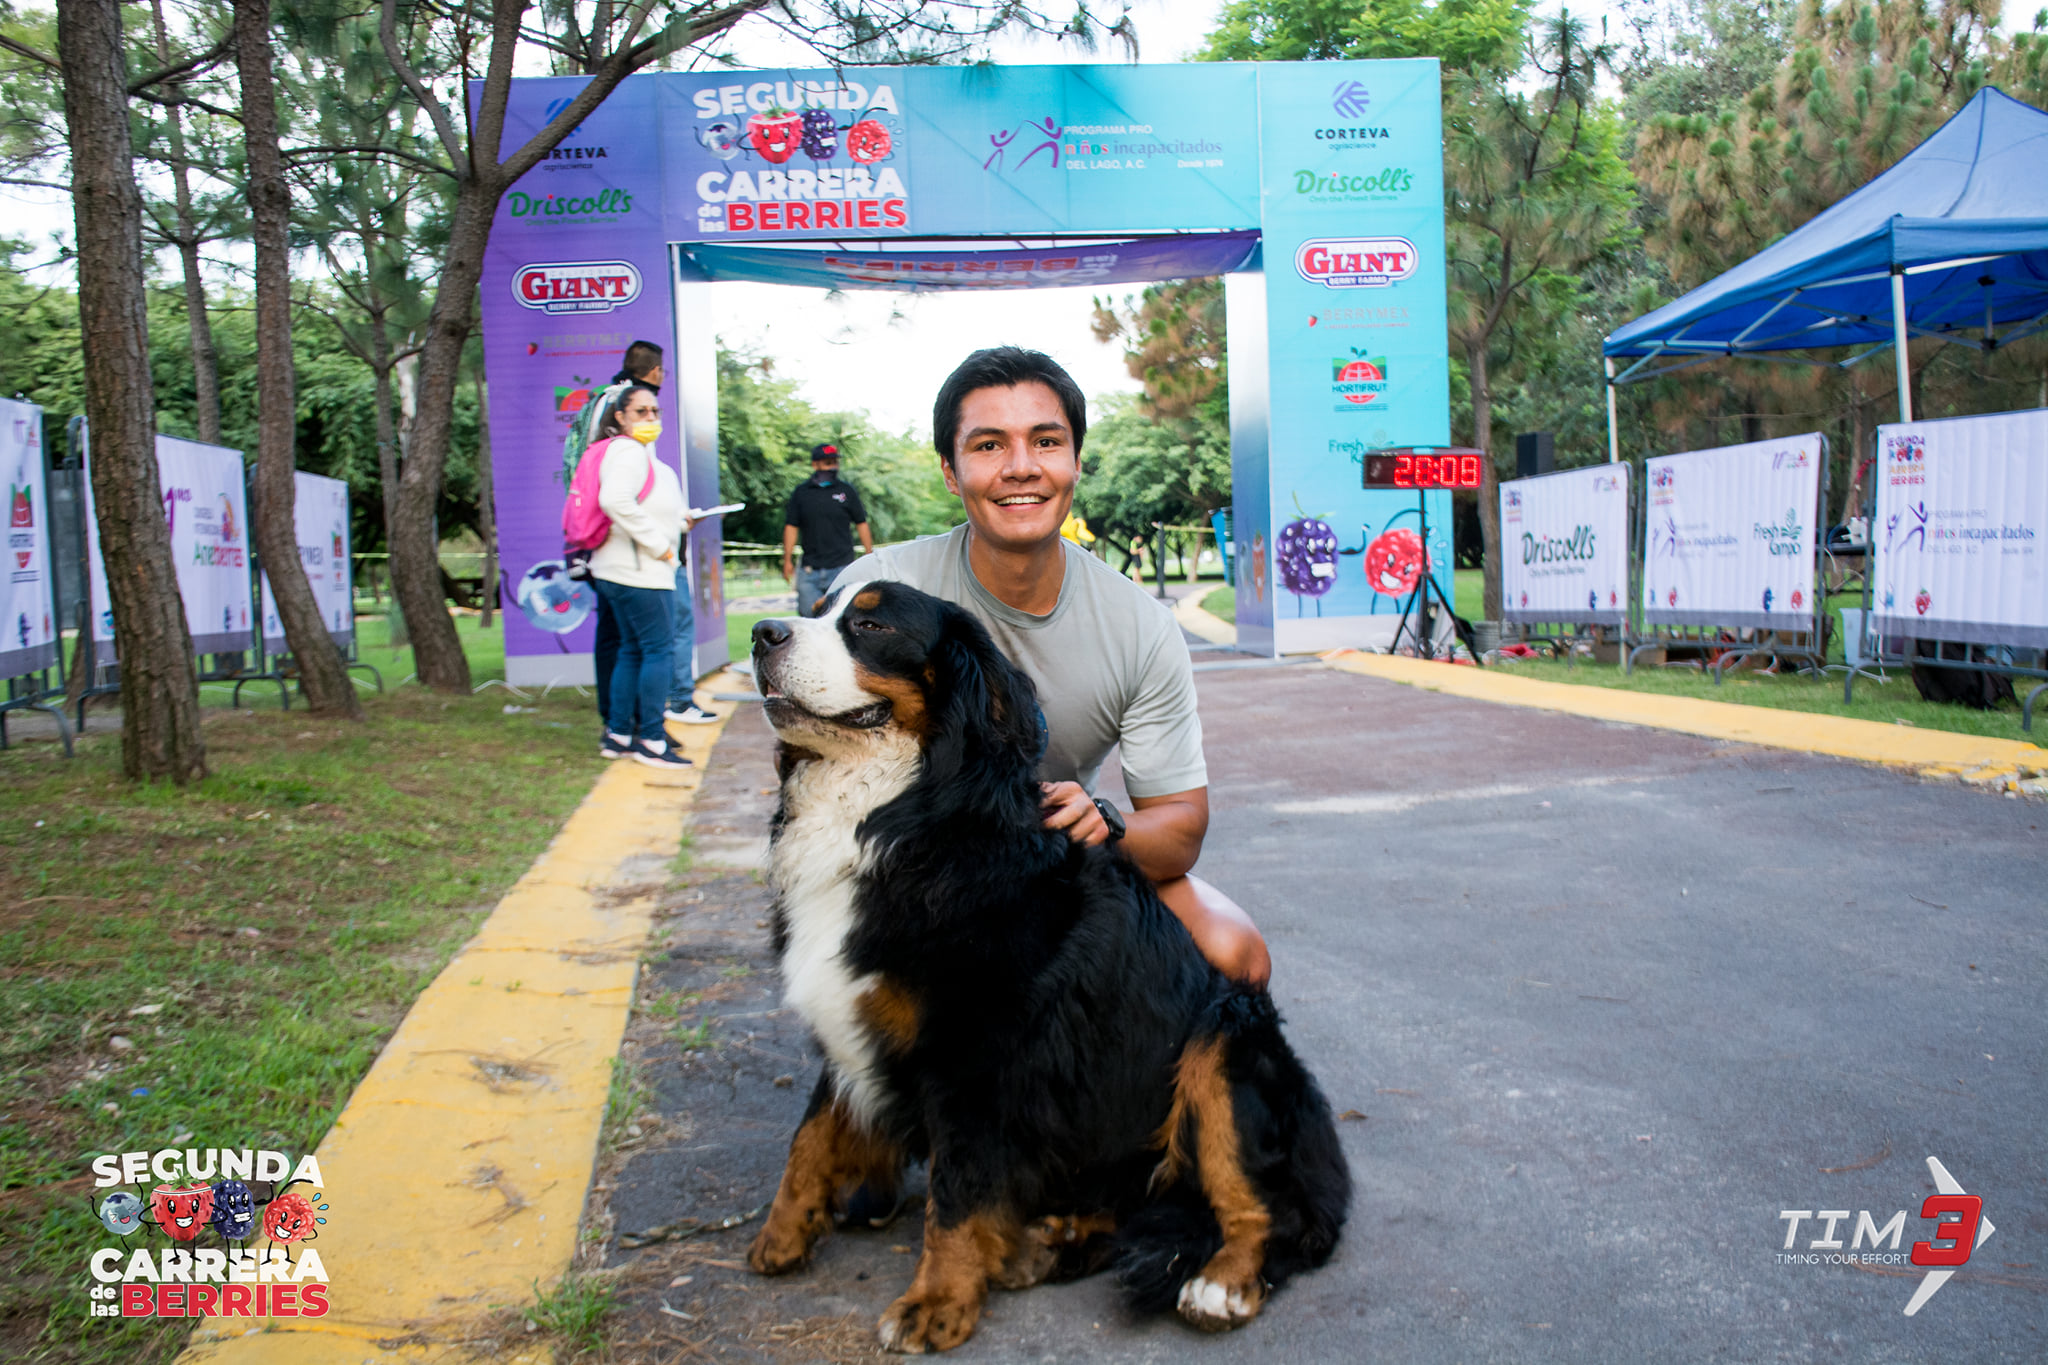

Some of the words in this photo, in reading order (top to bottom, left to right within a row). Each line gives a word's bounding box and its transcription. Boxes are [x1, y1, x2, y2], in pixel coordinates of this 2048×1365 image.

[693, 81, 899, 119] SEGUNDA
[1064, 125, 1127, 135] PROGRAMA
[1129, 124, 1153, 134] PRO
[1315, 128, 1390, 140] CORTEVA
[540, 147, 608, 160] ORTEVA
[1065, 140, 1109, 155] niños
[1114, 138, 1223, 158] incapacitados
[1066, 160, 1087, 170] DEL
[696, 168, 908, 202] CARRERA
[1293, 167, 1413, 194] Driscoll's
[507, 188, 633, 217] Driscoll's
[697, 204, 722, 218] de
[727, 199, 908, 231] BERRIES
[699, 219, 726, 233] las
[1304, 247, 1407, 274] GIANT
[521, 272, 629, 300] GIANT
[1332, 383, 1387, 393] HORTIFRUT
[1328, 439, 1364, 454] Fresh
[1521, 524, 1596, 565] Driscoll's
